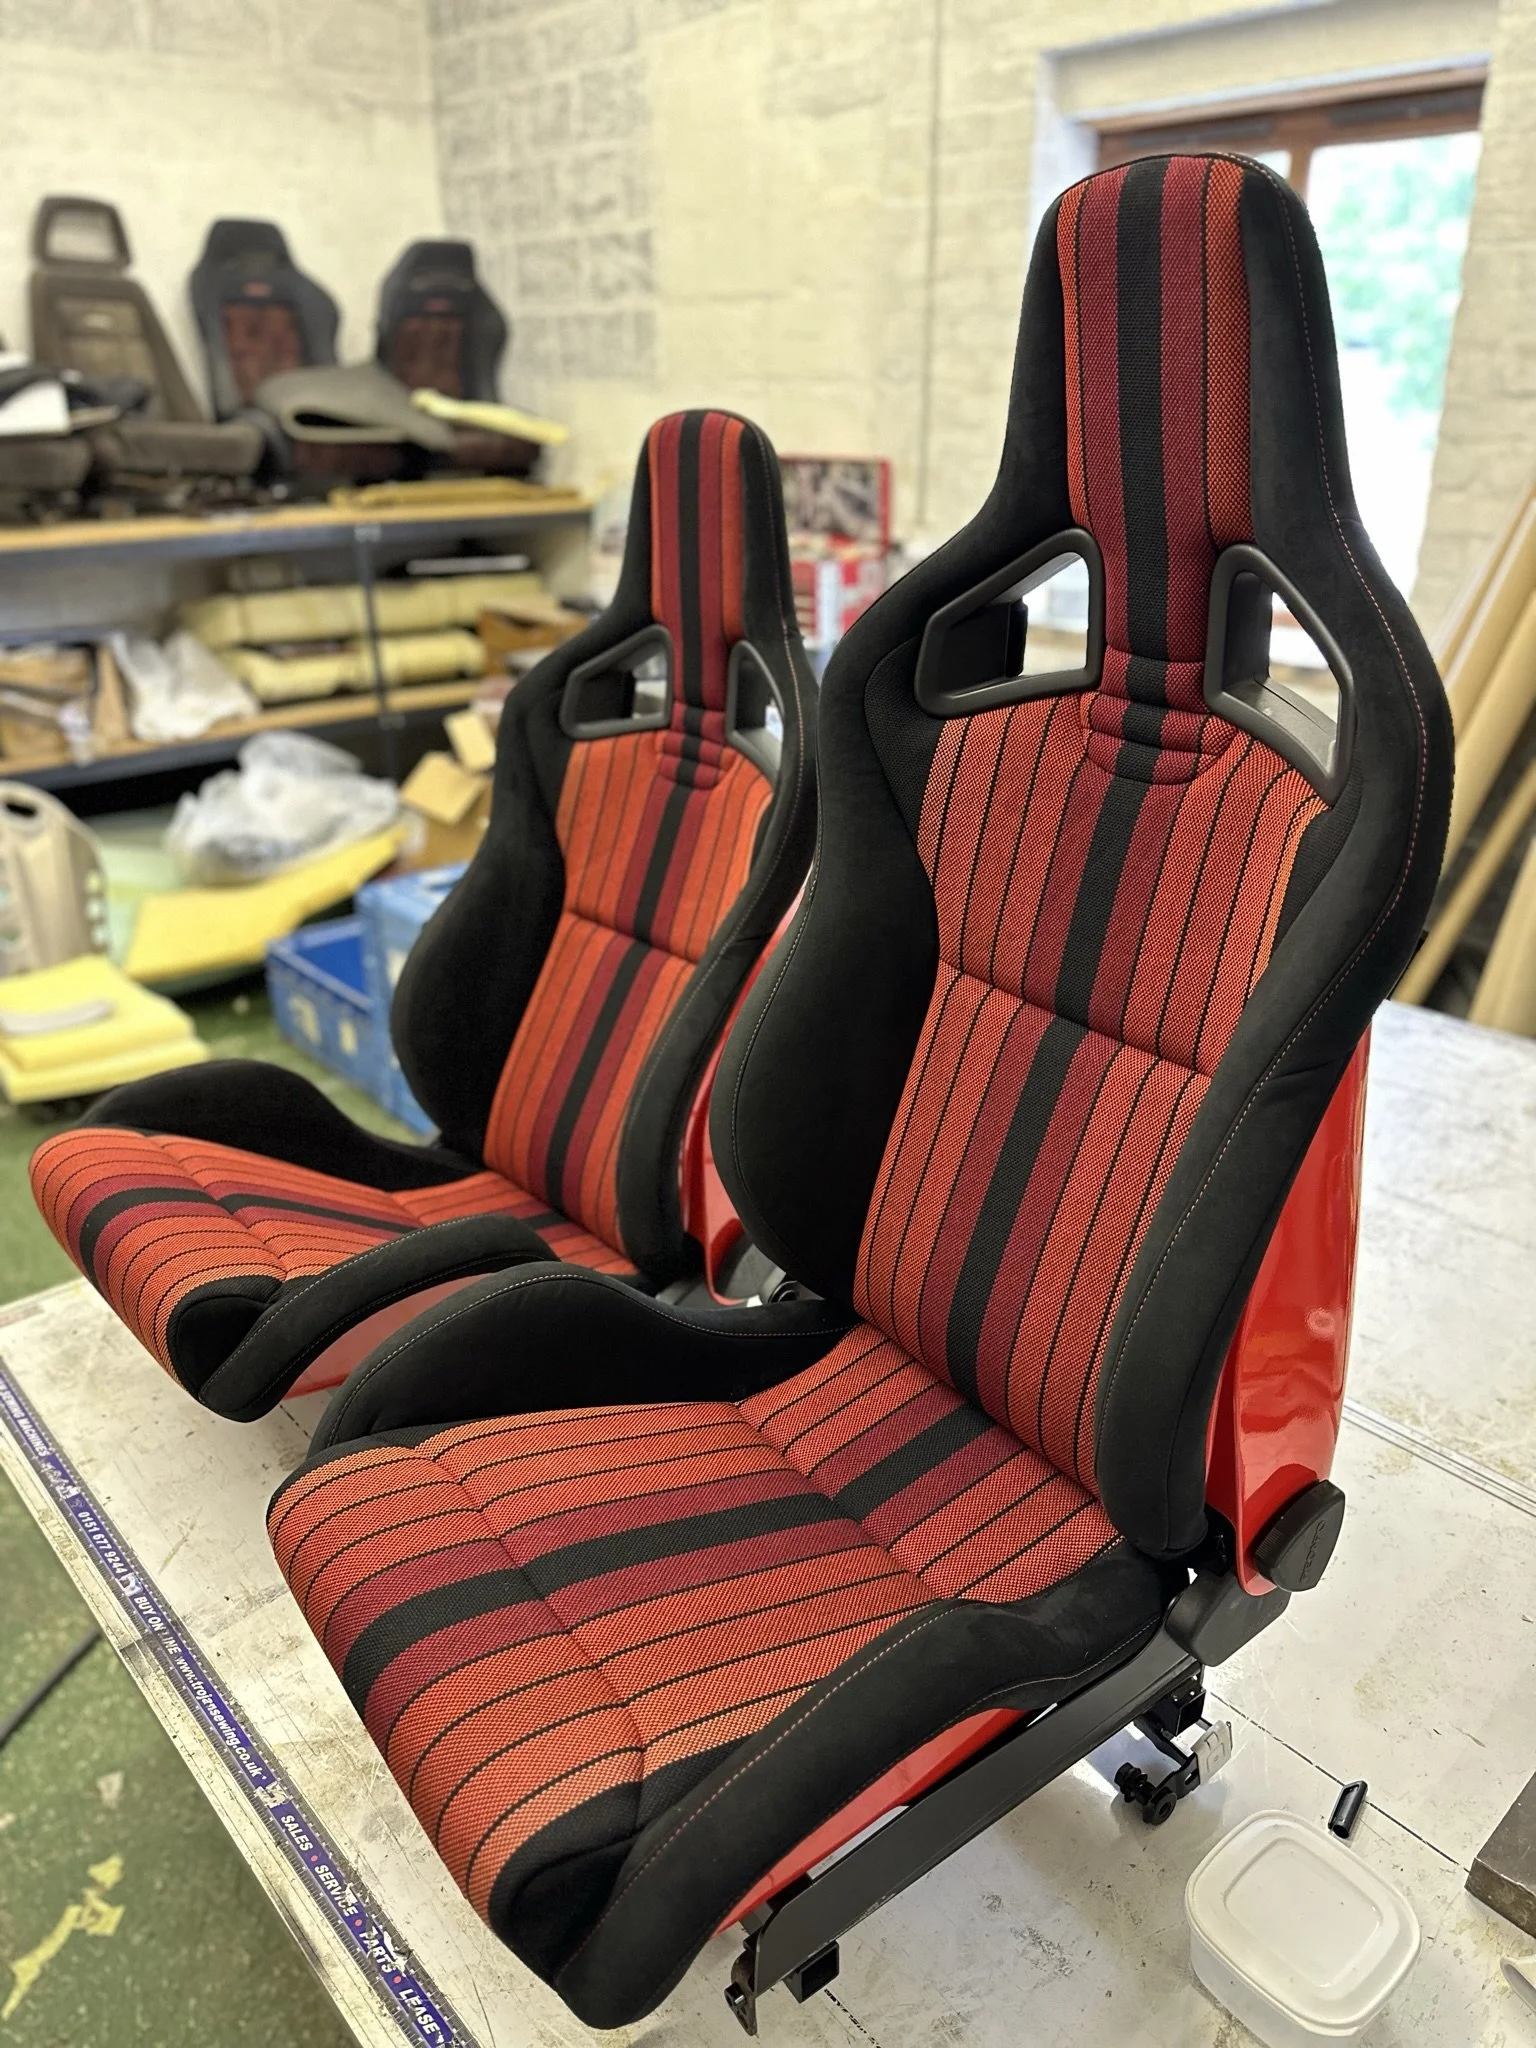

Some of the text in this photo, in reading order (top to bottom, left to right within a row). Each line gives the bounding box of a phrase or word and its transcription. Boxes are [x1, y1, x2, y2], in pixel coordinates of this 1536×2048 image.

[17, 1417, 51, 1457] MACHINES
[78, 1511, 100, 1533] 0151
[93, 1533, 112, 1550] 677
[104, 1550, 128, 1574] 9244
[133, 1596, 156, 1616] BUY
[175, 1655, 263, 1778] www.trojansewing.co.uk
[281, 1815, 314, 1851] SALES
[314, 1864, 358, 1917] SERVICE
[399, 1988, 440, 2035] LEASE
